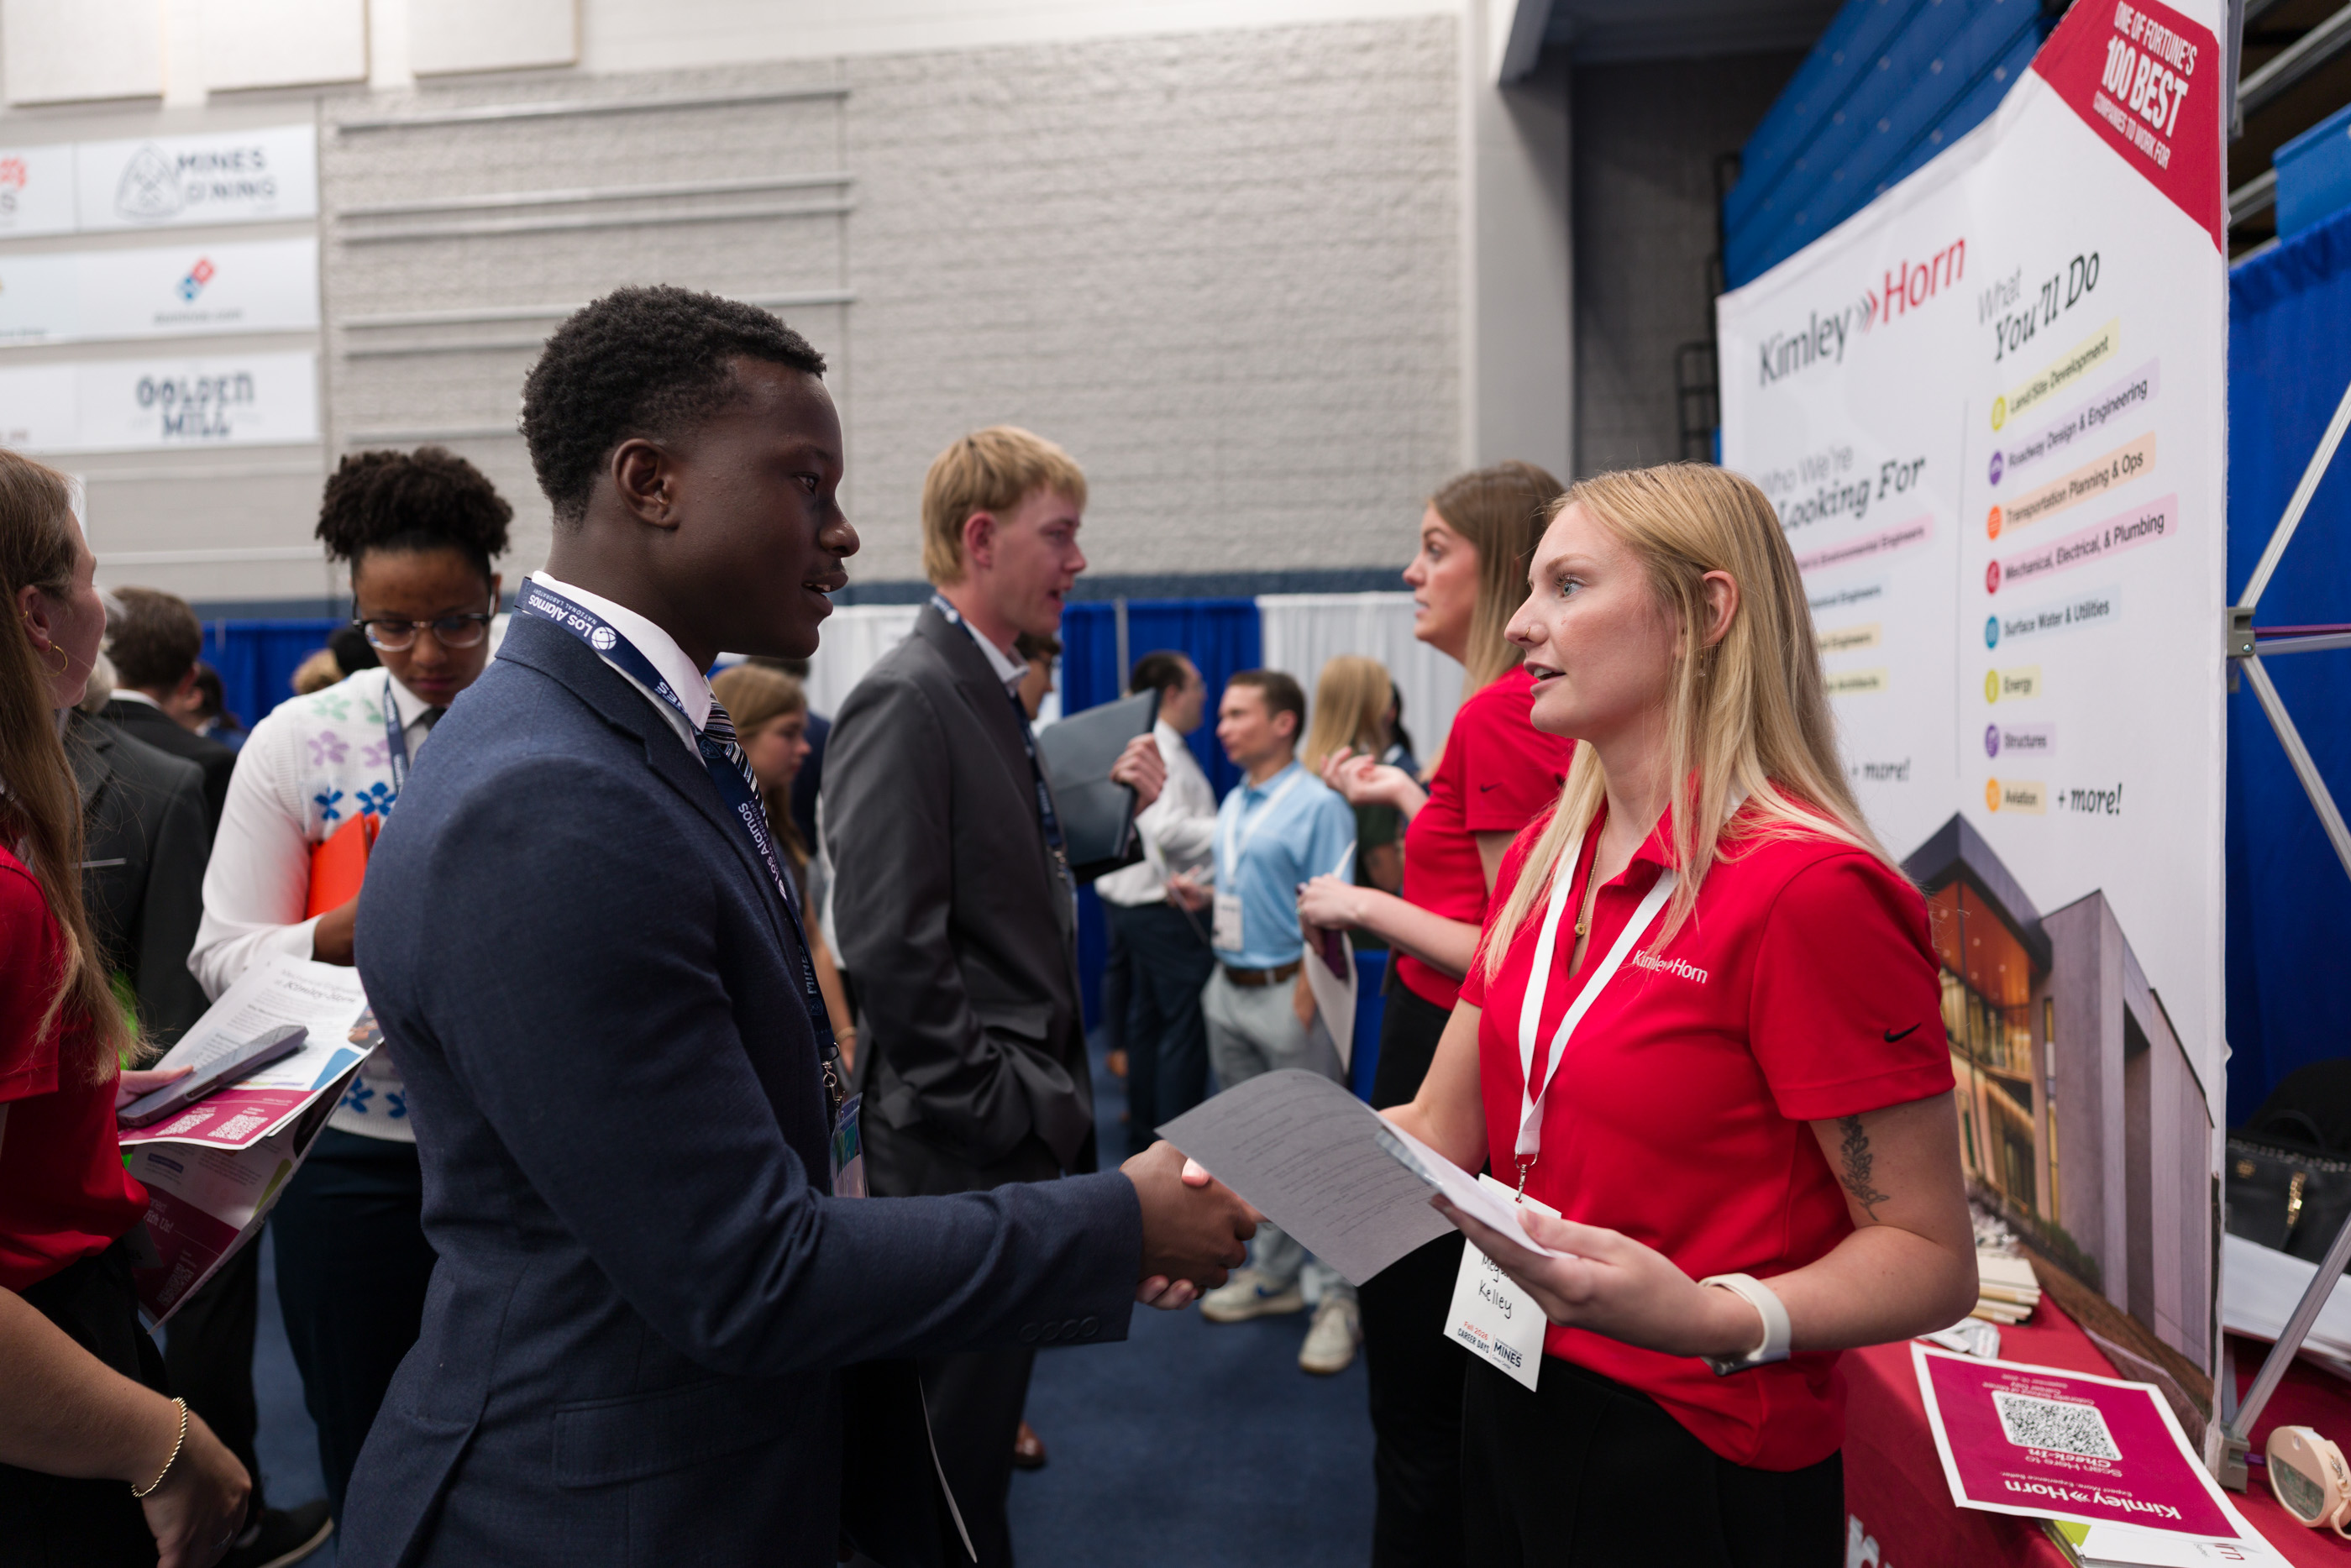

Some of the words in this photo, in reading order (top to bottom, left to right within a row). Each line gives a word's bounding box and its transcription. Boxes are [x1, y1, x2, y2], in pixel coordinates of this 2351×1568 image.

[2114, 0, 2134, 35] ONE
[2130, 11, 2147, 42] OF
[2142, 18, 2197, 76] FORTUNE'S
[2102, 34, 2136, 102] 100
[2128, 54, 2189, 138] BEST
[2124, 116, 2137, 142] TO
[2154, 140, 2170, 170] FOR
[176, 145, 266, 172] MINES
[185, 176, 276, 203] DINING
[1978, 264, 2022, 326] What
[1996, 270, 2060, 363] You'll
[2065, 250, 2101, 311] Do
[1760, 305, 1851, 388] Kimley
[1882, 237, 1965, 324] Horn
[2049, 334, 2109, 388] Development
[136, 370, 255, 409] GOLDEN
[161, 412, 232, 438] MILL
[2047, 421, 2077, 450] Design
[2079, 412, 2086, 433] &
[2088, 379, 2149, 425] Engineering
[1778, 479, 1871, 532] Looking
[1877, 456, 1926, 501] For
[2006, 489, 2068, 526] Transportation
[2068, 467, 2110, 500] Planning
[2112, 459, 2119, 480] &
[2122, 451, 2144, 475] Ops
[2005, 552, 2055, 581] Mechanical,
[2055, 533, 2102, 566] Electrical,
[2104, 529, 2111, 549] &
[2114, 512, 2165, 546] Plumbing
[528, 594, 569, 622] Alamos
[564, 603, 598, 626] NATIONAL
[2004, 620, 2037, 637] Surface
[2038, 611, 2064, 630] Water
[2065, 606, 2072, 625] &
[2074, 599, 2110, 623] Utilities
[566, 615, 594, 637] Los
[2004, 675, 2034, 695] Energy
[2004, 732, 2048, 751] Structures
[1864, 758, 1911, 782] more!
[2004, 789, 2039, 807] Aviation
[2070, 782, 2123, 816] more!
[737, 802, 769, 856] Alamos
[748, 800, 769, 842] LABORATORY
[766, 856, 779, 882] Los
[799, 945, 817, 994] MINES
[1671, 957, 1708, 983] Horn
[1478, 1279, 1512, 1319] Kelley
[1463, 1321, 1474, 1333] Fall
[1457, 1328, 1477, 1345] CAREER
[1476, 1340, 1490, 1355] DAYS
[1493, 1341, 1522, 1368] MINES
[2024, 1455, 2042, 1465] to
[2028, 1448, 2112, 1468] Check-In
[2044, 1458, 2081, 1471] Here
[2083, 1465, 2123, 1478] Scan
[2004, 1480, 2070, 1502] Horn
[2027, 1474, 2075, 1488] Experience
[2103, 1487, 2133, 1497] Expect
[2093, 1492, 2182, 1520] Kimley
